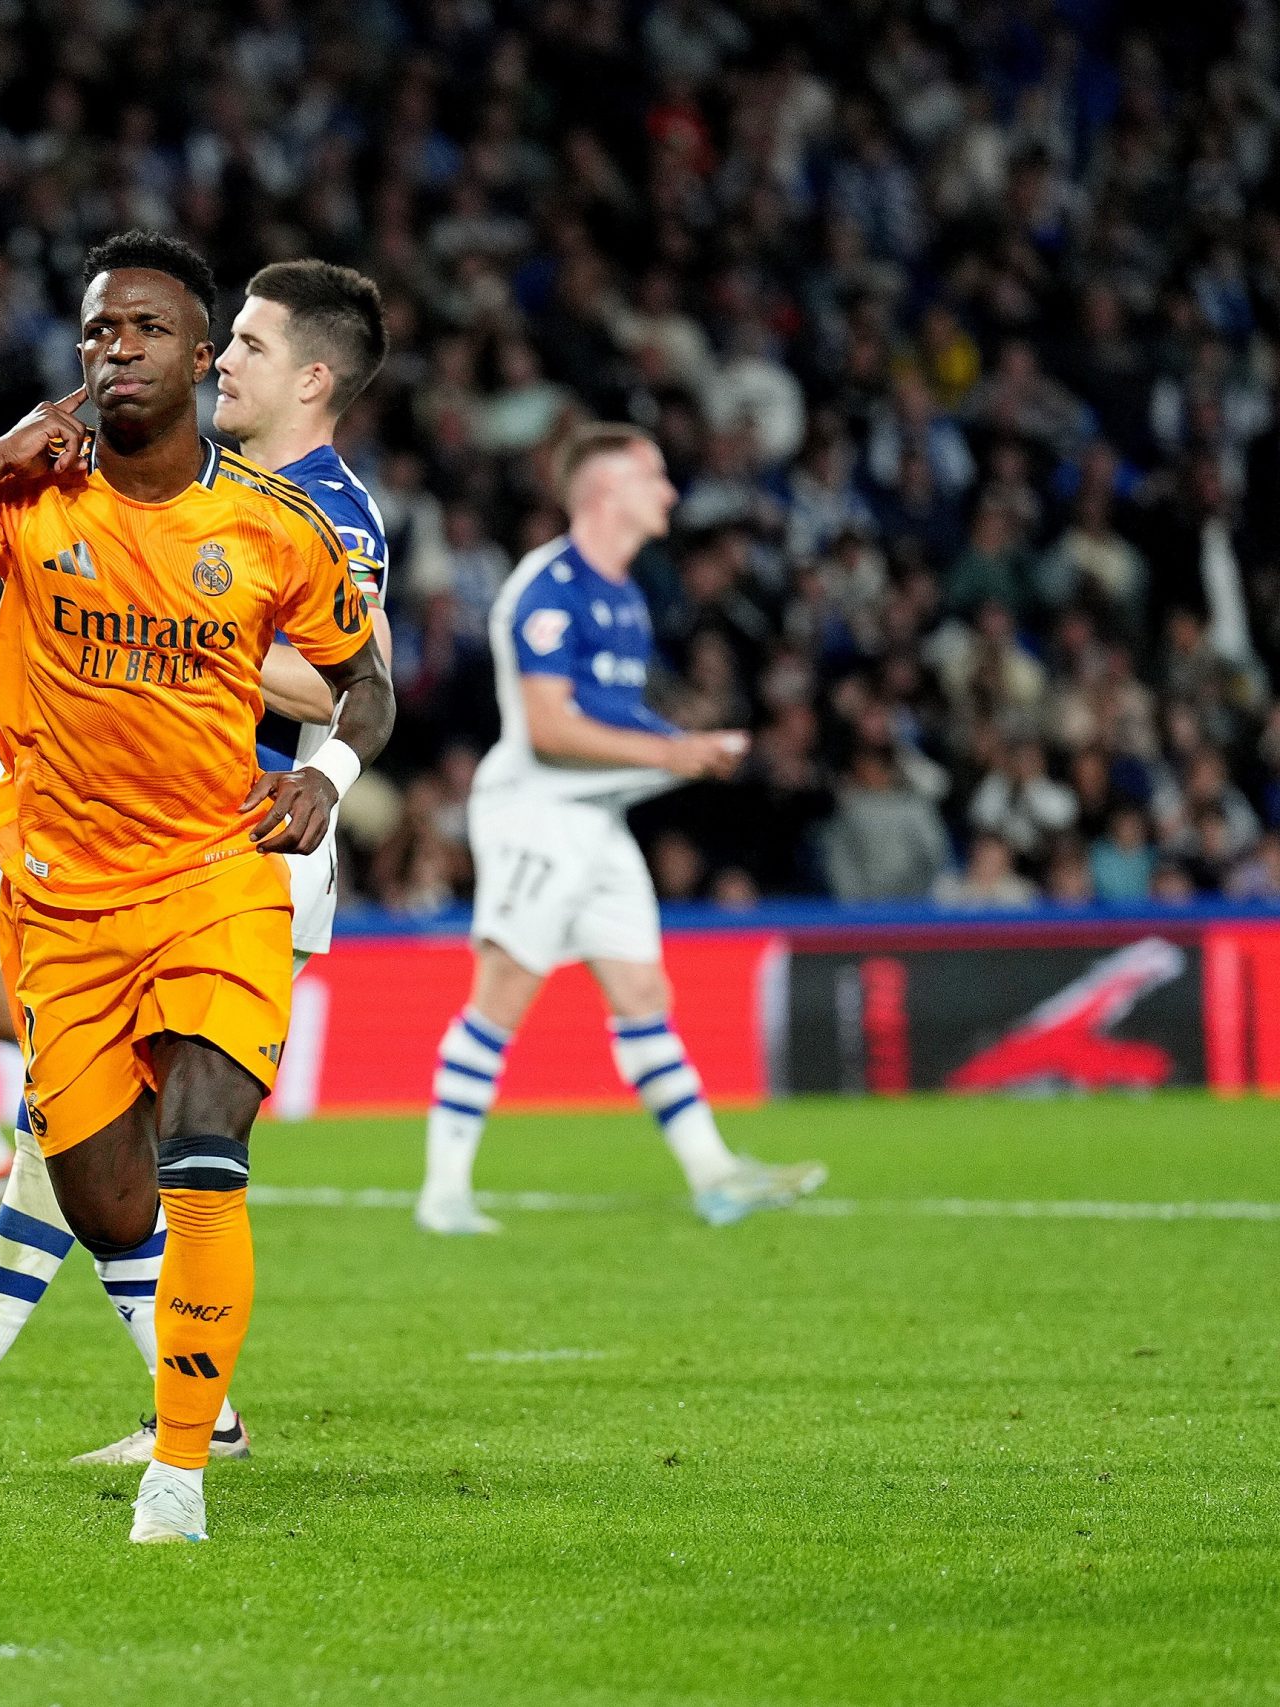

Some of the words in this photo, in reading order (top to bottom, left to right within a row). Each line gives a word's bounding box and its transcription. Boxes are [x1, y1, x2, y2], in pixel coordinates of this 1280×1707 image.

[52, 595, 237, 650] Emirates
[79, 645, 118, 680] FLY
[125, 650, 204, 684] BETTER
[169, 1297, 233, 1323] RMCF
